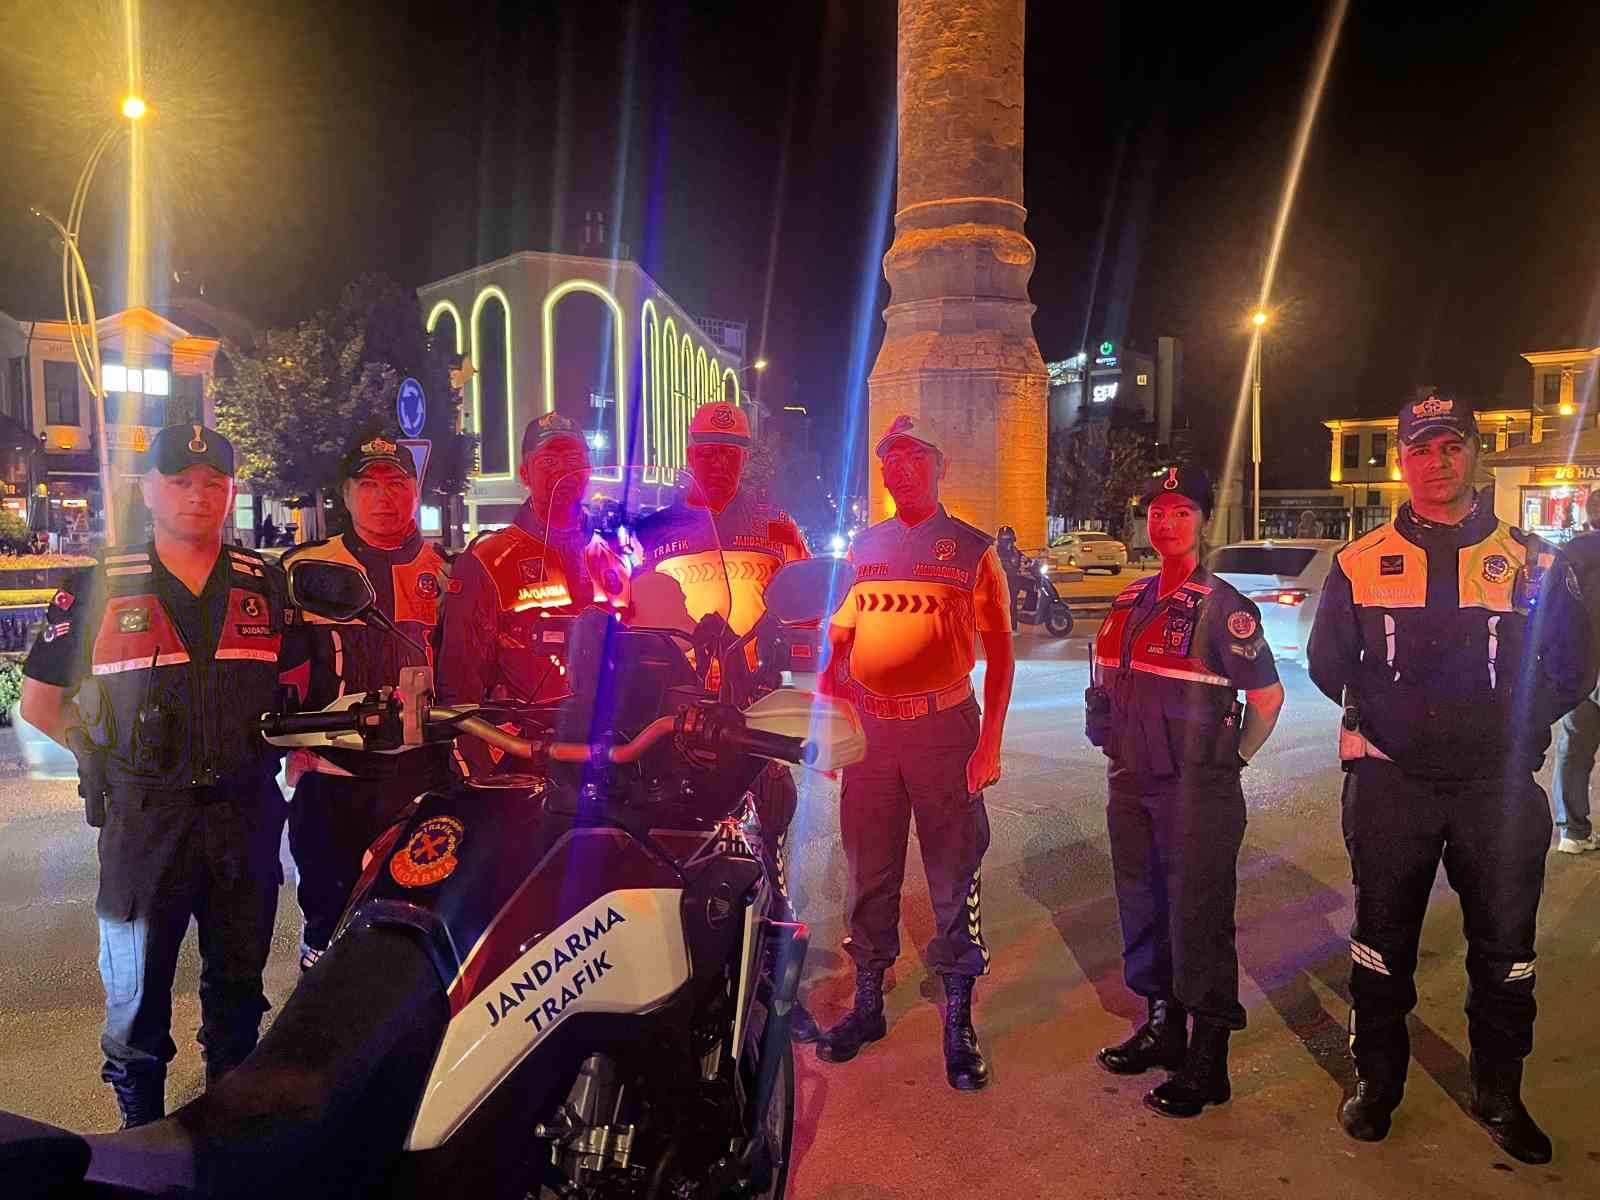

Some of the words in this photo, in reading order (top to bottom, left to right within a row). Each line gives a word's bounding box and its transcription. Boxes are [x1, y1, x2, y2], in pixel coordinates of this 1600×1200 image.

[653, 538, 689, 559] TRAFİK
[486, 906, 626, 1027] JANDARMA
[524, 950, 614, 1032] TRAFİK
